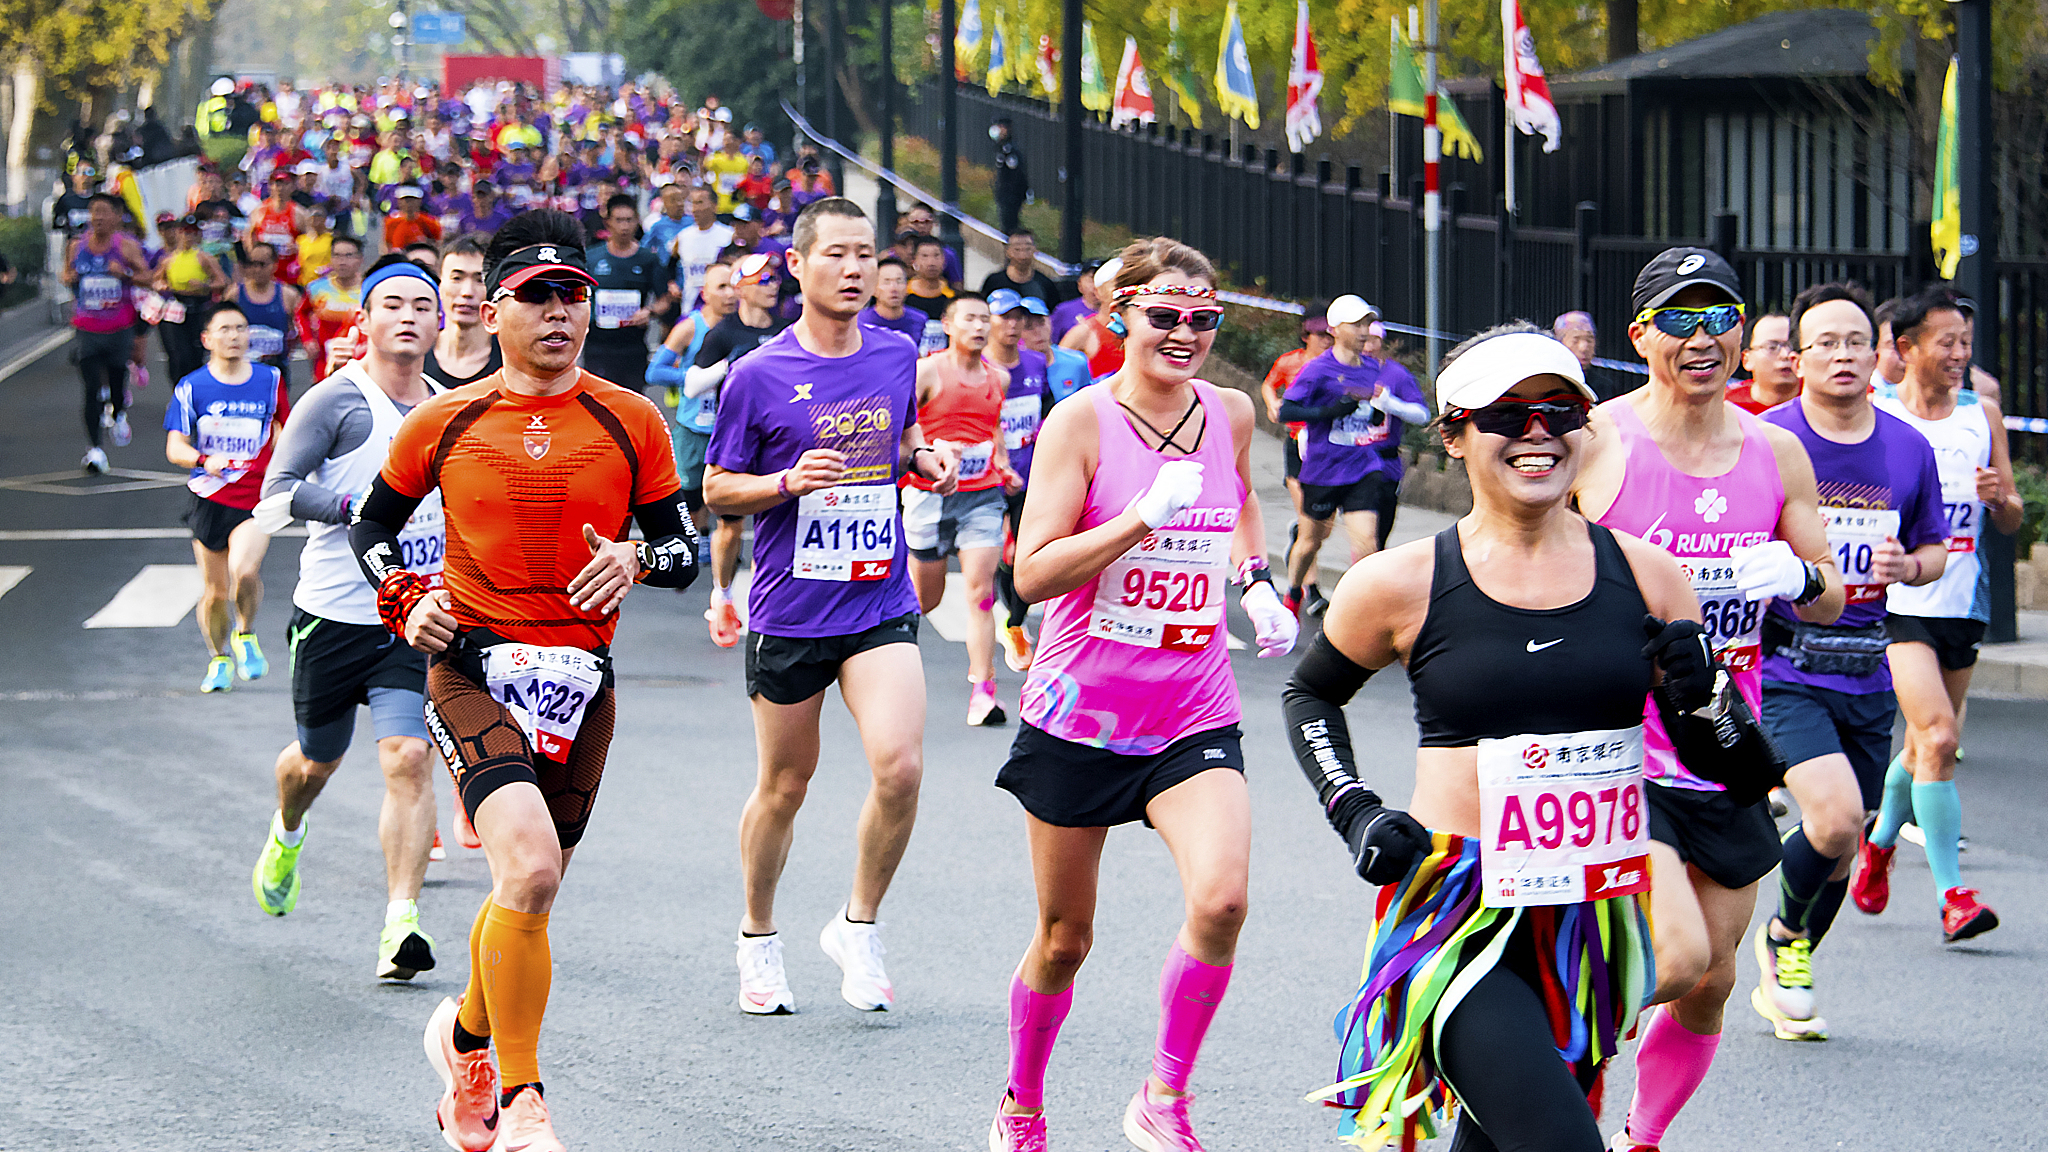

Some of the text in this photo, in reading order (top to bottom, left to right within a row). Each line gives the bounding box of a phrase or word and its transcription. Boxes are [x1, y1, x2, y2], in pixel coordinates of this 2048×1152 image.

[816, 407, 892, 439] 2020
[802, 517, 892, 551] A1164
[401, 535, 445, 568] 032
[1119, 567, 1209, 612] 9520
[1701, 598, 1759, 639] 668
[1556, 740, 1625, 764] 南京银行
[1494, 783, 1640, 852] A9978
